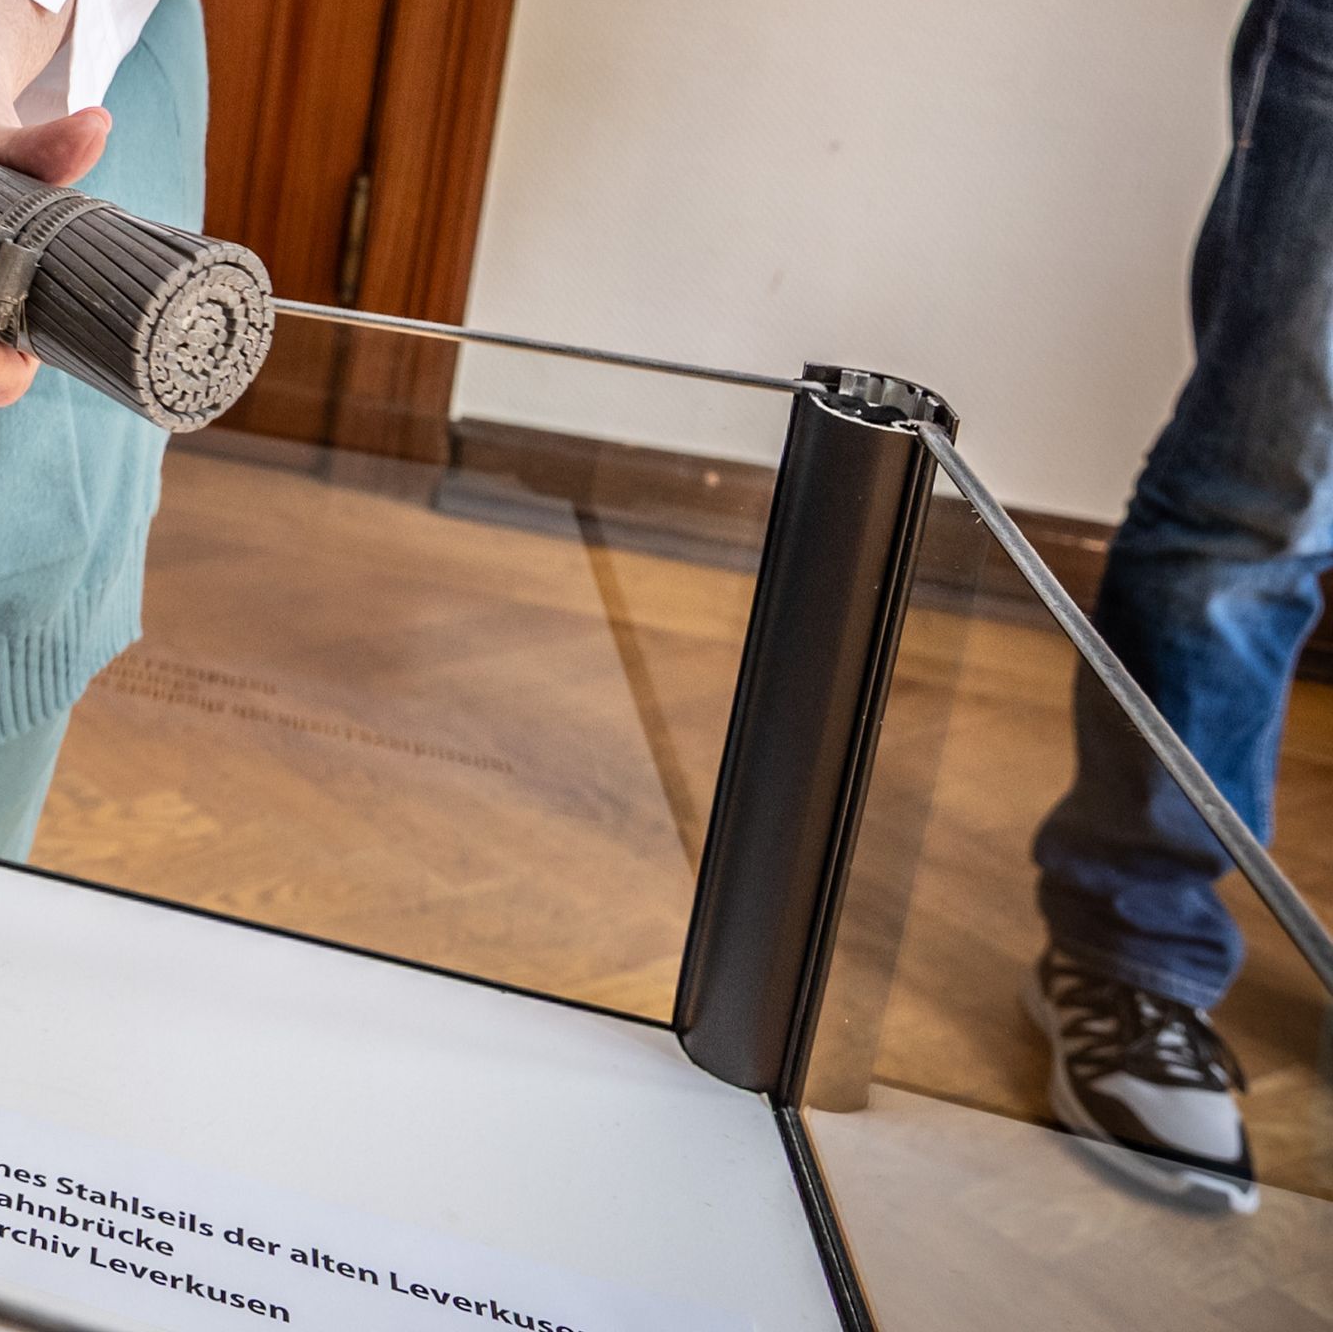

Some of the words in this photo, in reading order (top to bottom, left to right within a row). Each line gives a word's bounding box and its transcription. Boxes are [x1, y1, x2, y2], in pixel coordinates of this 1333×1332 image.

[56, 1177, 214, 1237] Stahlseils
[223, 1226, 281, 1257] der
[290, 1246, 379, 1286] alten
[389, 1271, 587, 1332] Leverkus
[89, 1245, 291, 1324] Leverkusen
